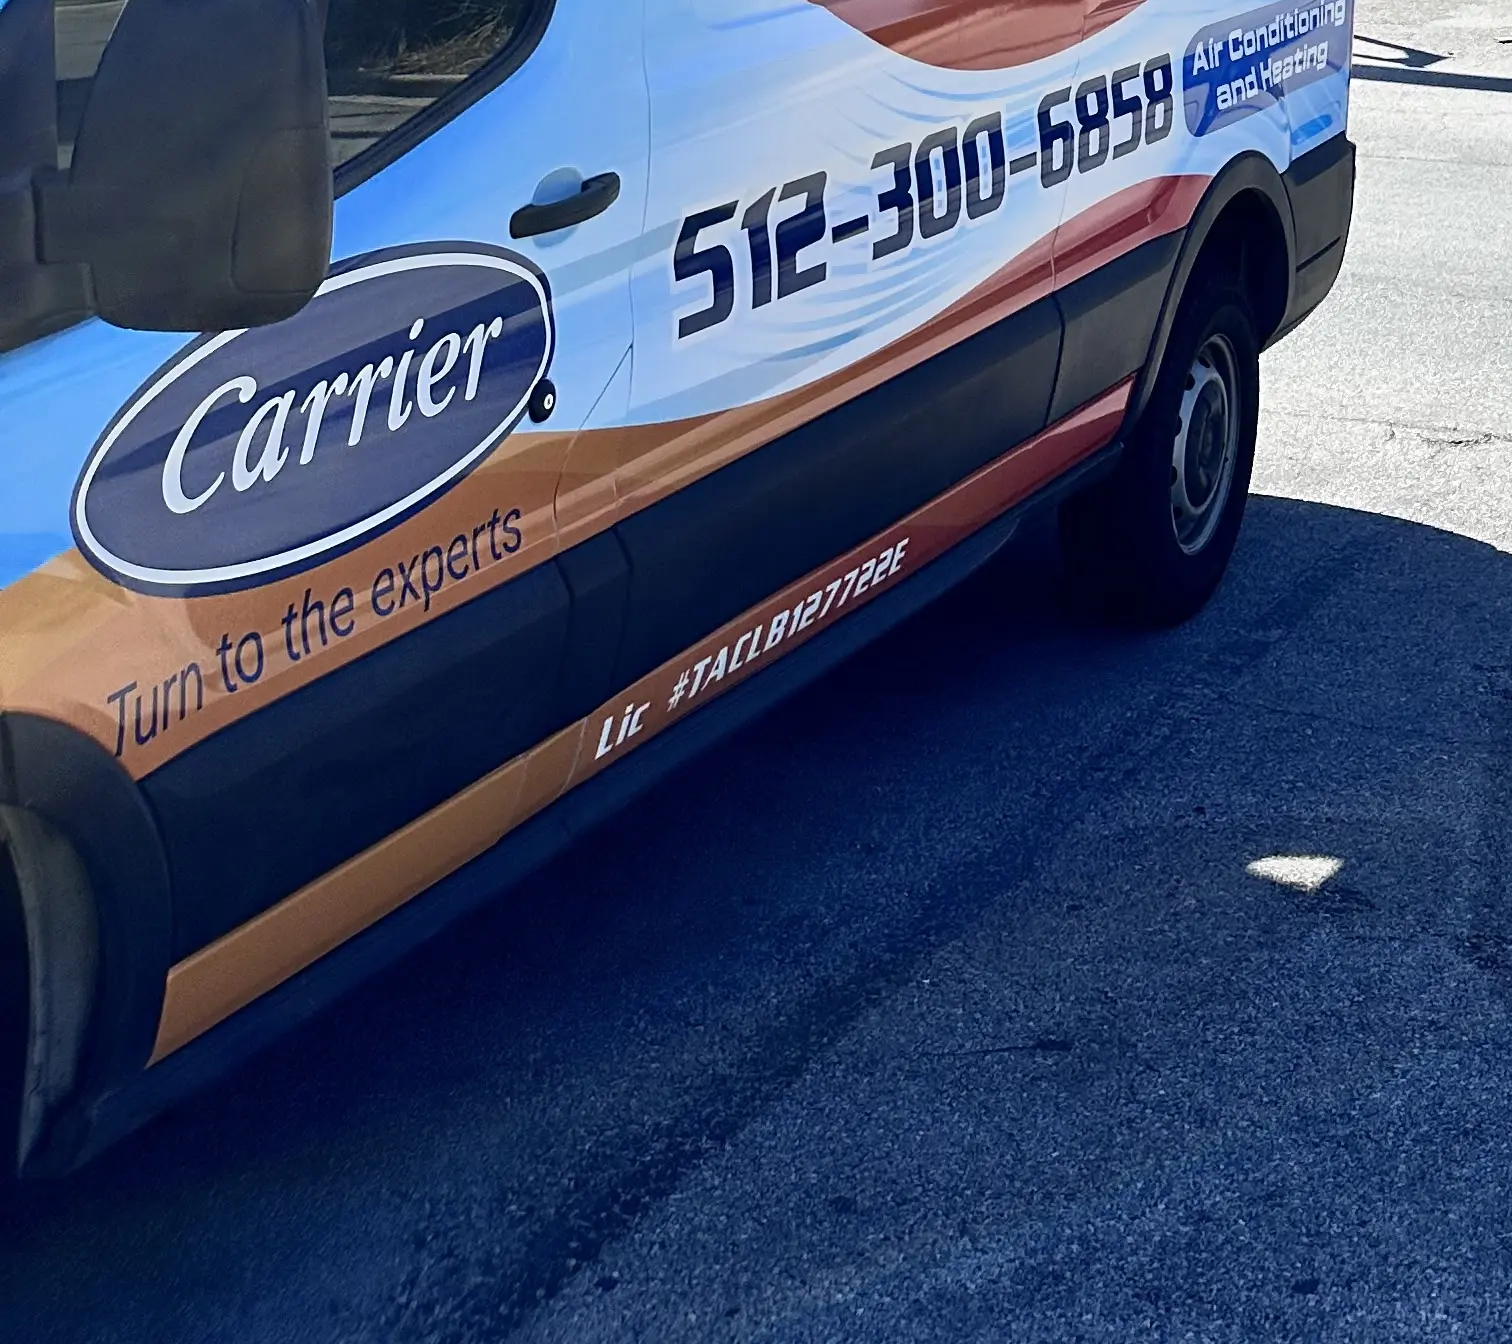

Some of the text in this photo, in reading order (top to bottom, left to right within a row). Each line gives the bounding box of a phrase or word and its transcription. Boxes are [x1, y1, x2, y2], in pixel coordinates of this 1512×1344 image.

[1193, 0, 1346, 76] Air Conditioning
[1217, 41, 1329, 110] and Heating
[673, 52, 1173, 339] 512-300-6858
[161, 313, 504, 514] Carrier
[107, 508, 522, 757] Turn to the experts
[594, 538, 909, 761] Lic #TACLB127722E
